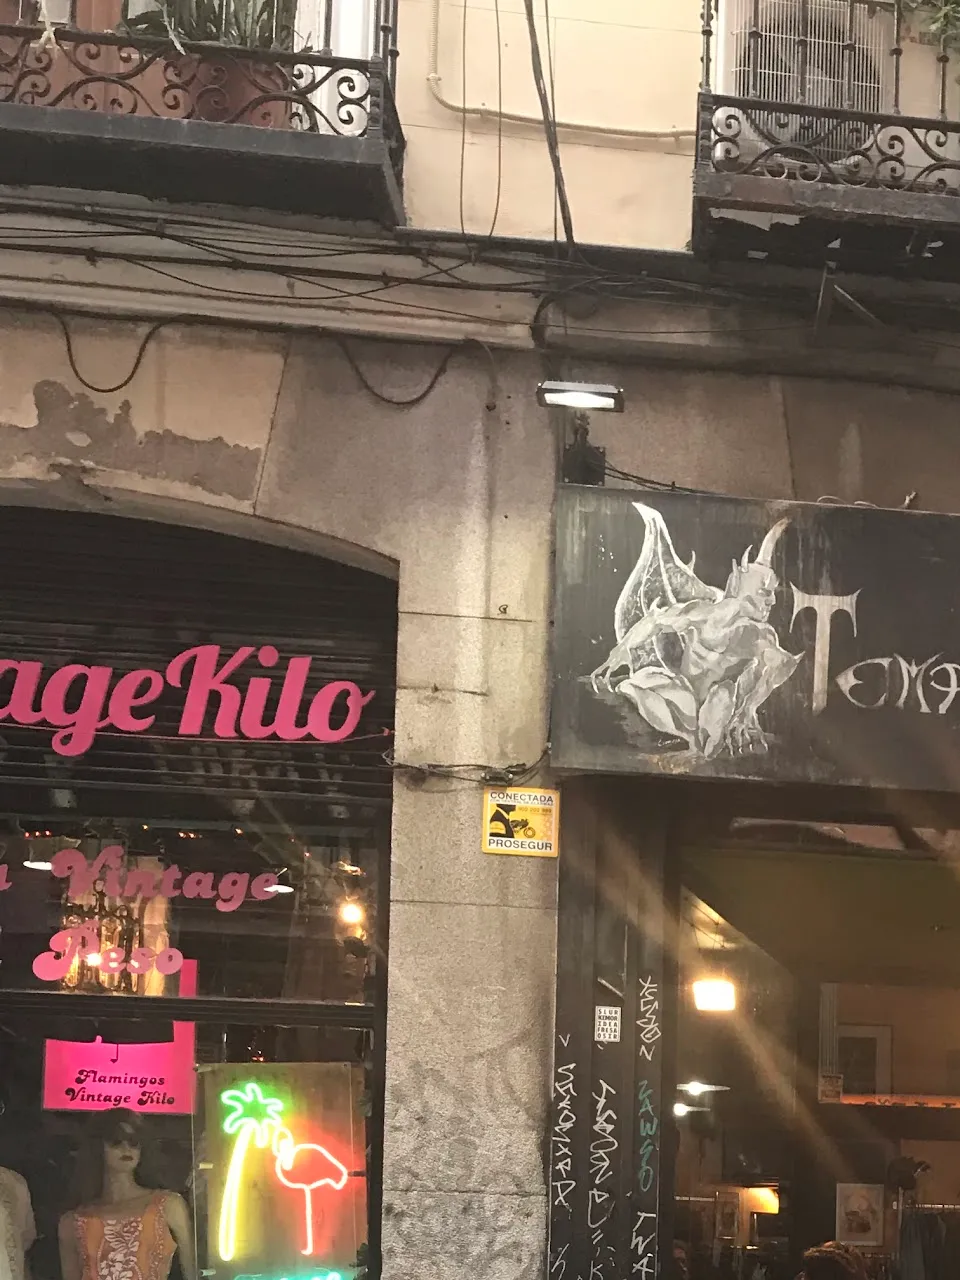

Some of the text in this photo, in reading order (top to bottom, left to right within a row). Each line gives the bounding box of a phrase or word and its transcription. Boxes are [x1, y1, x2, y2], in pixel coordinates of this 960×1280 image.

[490, 791, 554, 803] CONECTADA
[488, 838, 553, 851] PROSEGUR
[51, 845, 280, 912] Vintage
[32, 919, 184, 981] Peso
[75, 1068, 165, 1087] Flamingos
[64, 1087, 175, 1106] Vintage Kilo
